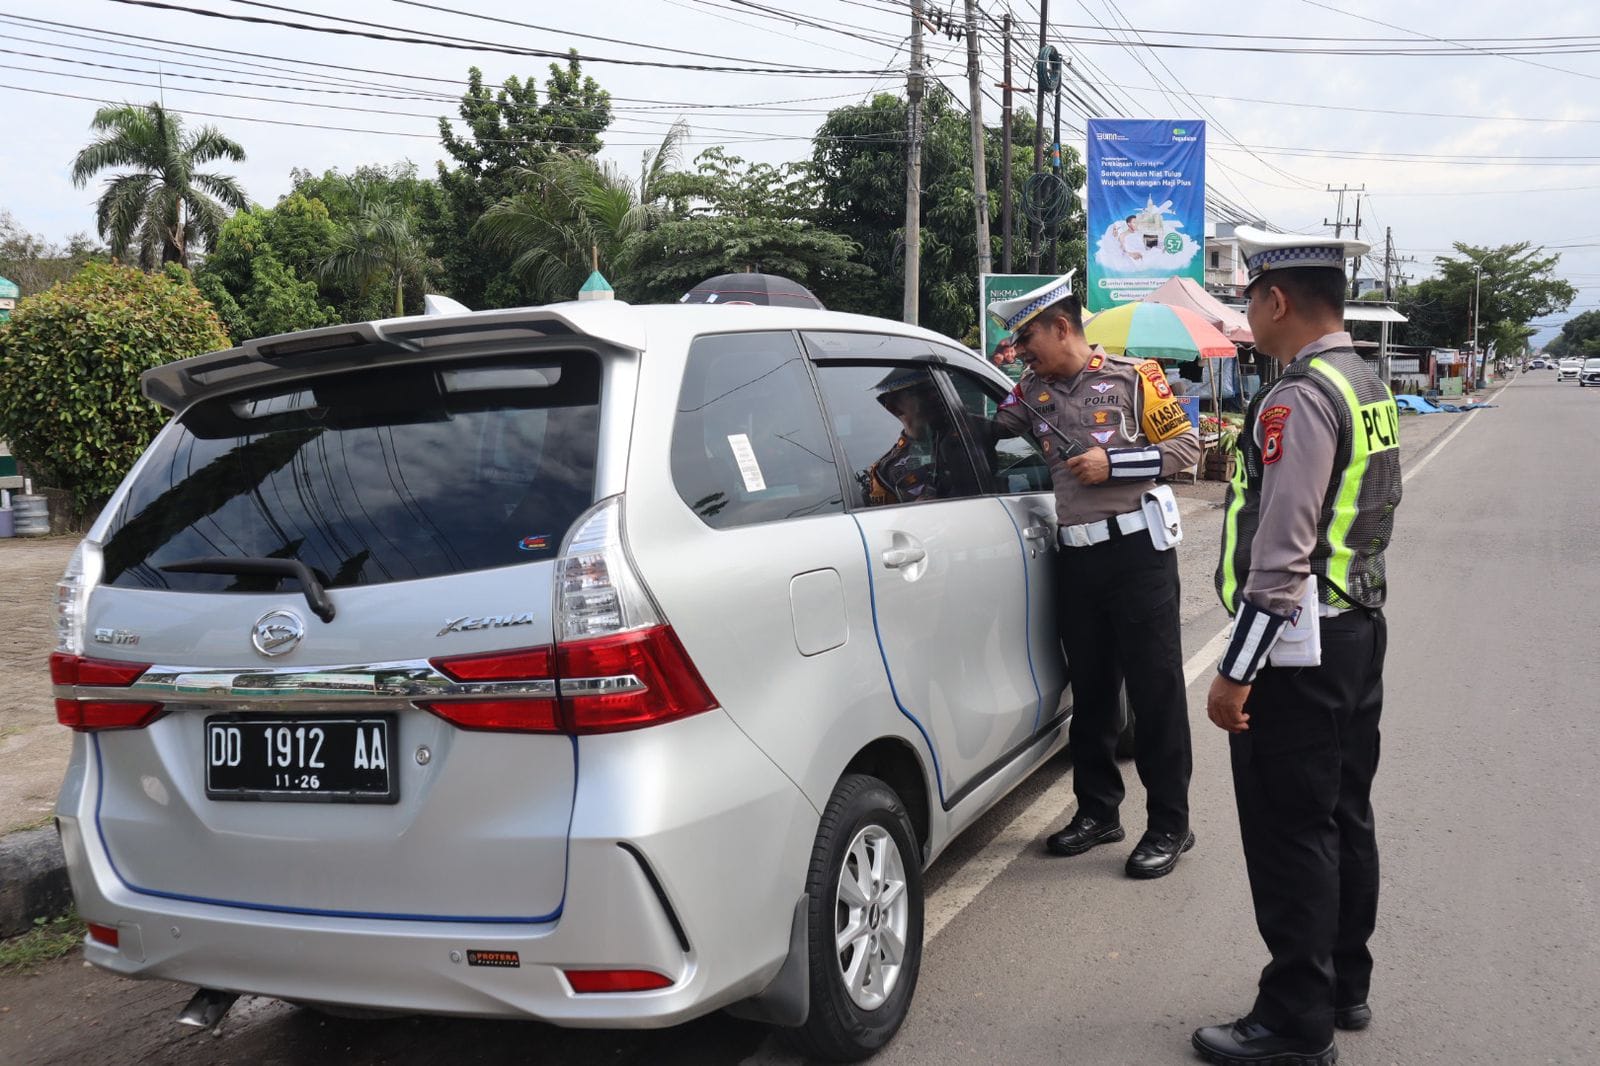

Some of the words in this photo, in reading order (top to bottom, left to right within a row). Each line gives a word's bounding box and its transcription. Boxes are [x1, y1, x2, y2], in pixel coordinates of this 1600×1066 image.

[1101, 170, 1148, 178] Sempurnakan
[1149, 170, 1163, 178] Niat
[1164, 170, 1182, 178] Tulus
[1101, 179, 1135, 187] Wujudkan
[1136, 179, 1161, 187] dengan
[1162, 179, 1176, 187] Haji
[1177, 179, 1191, 187] Plus
[990, 289, 1023, 297] NIKMAT
[1084, 395, 1119, 406] POLRI
[436, 612, 534, 638] XENIA
[211, 727, 241, 767] DD
[264, 727, 326, 769] 1912
[354, 727, 386, 770] AA
[476, 952, 518, 961] PROTERA
